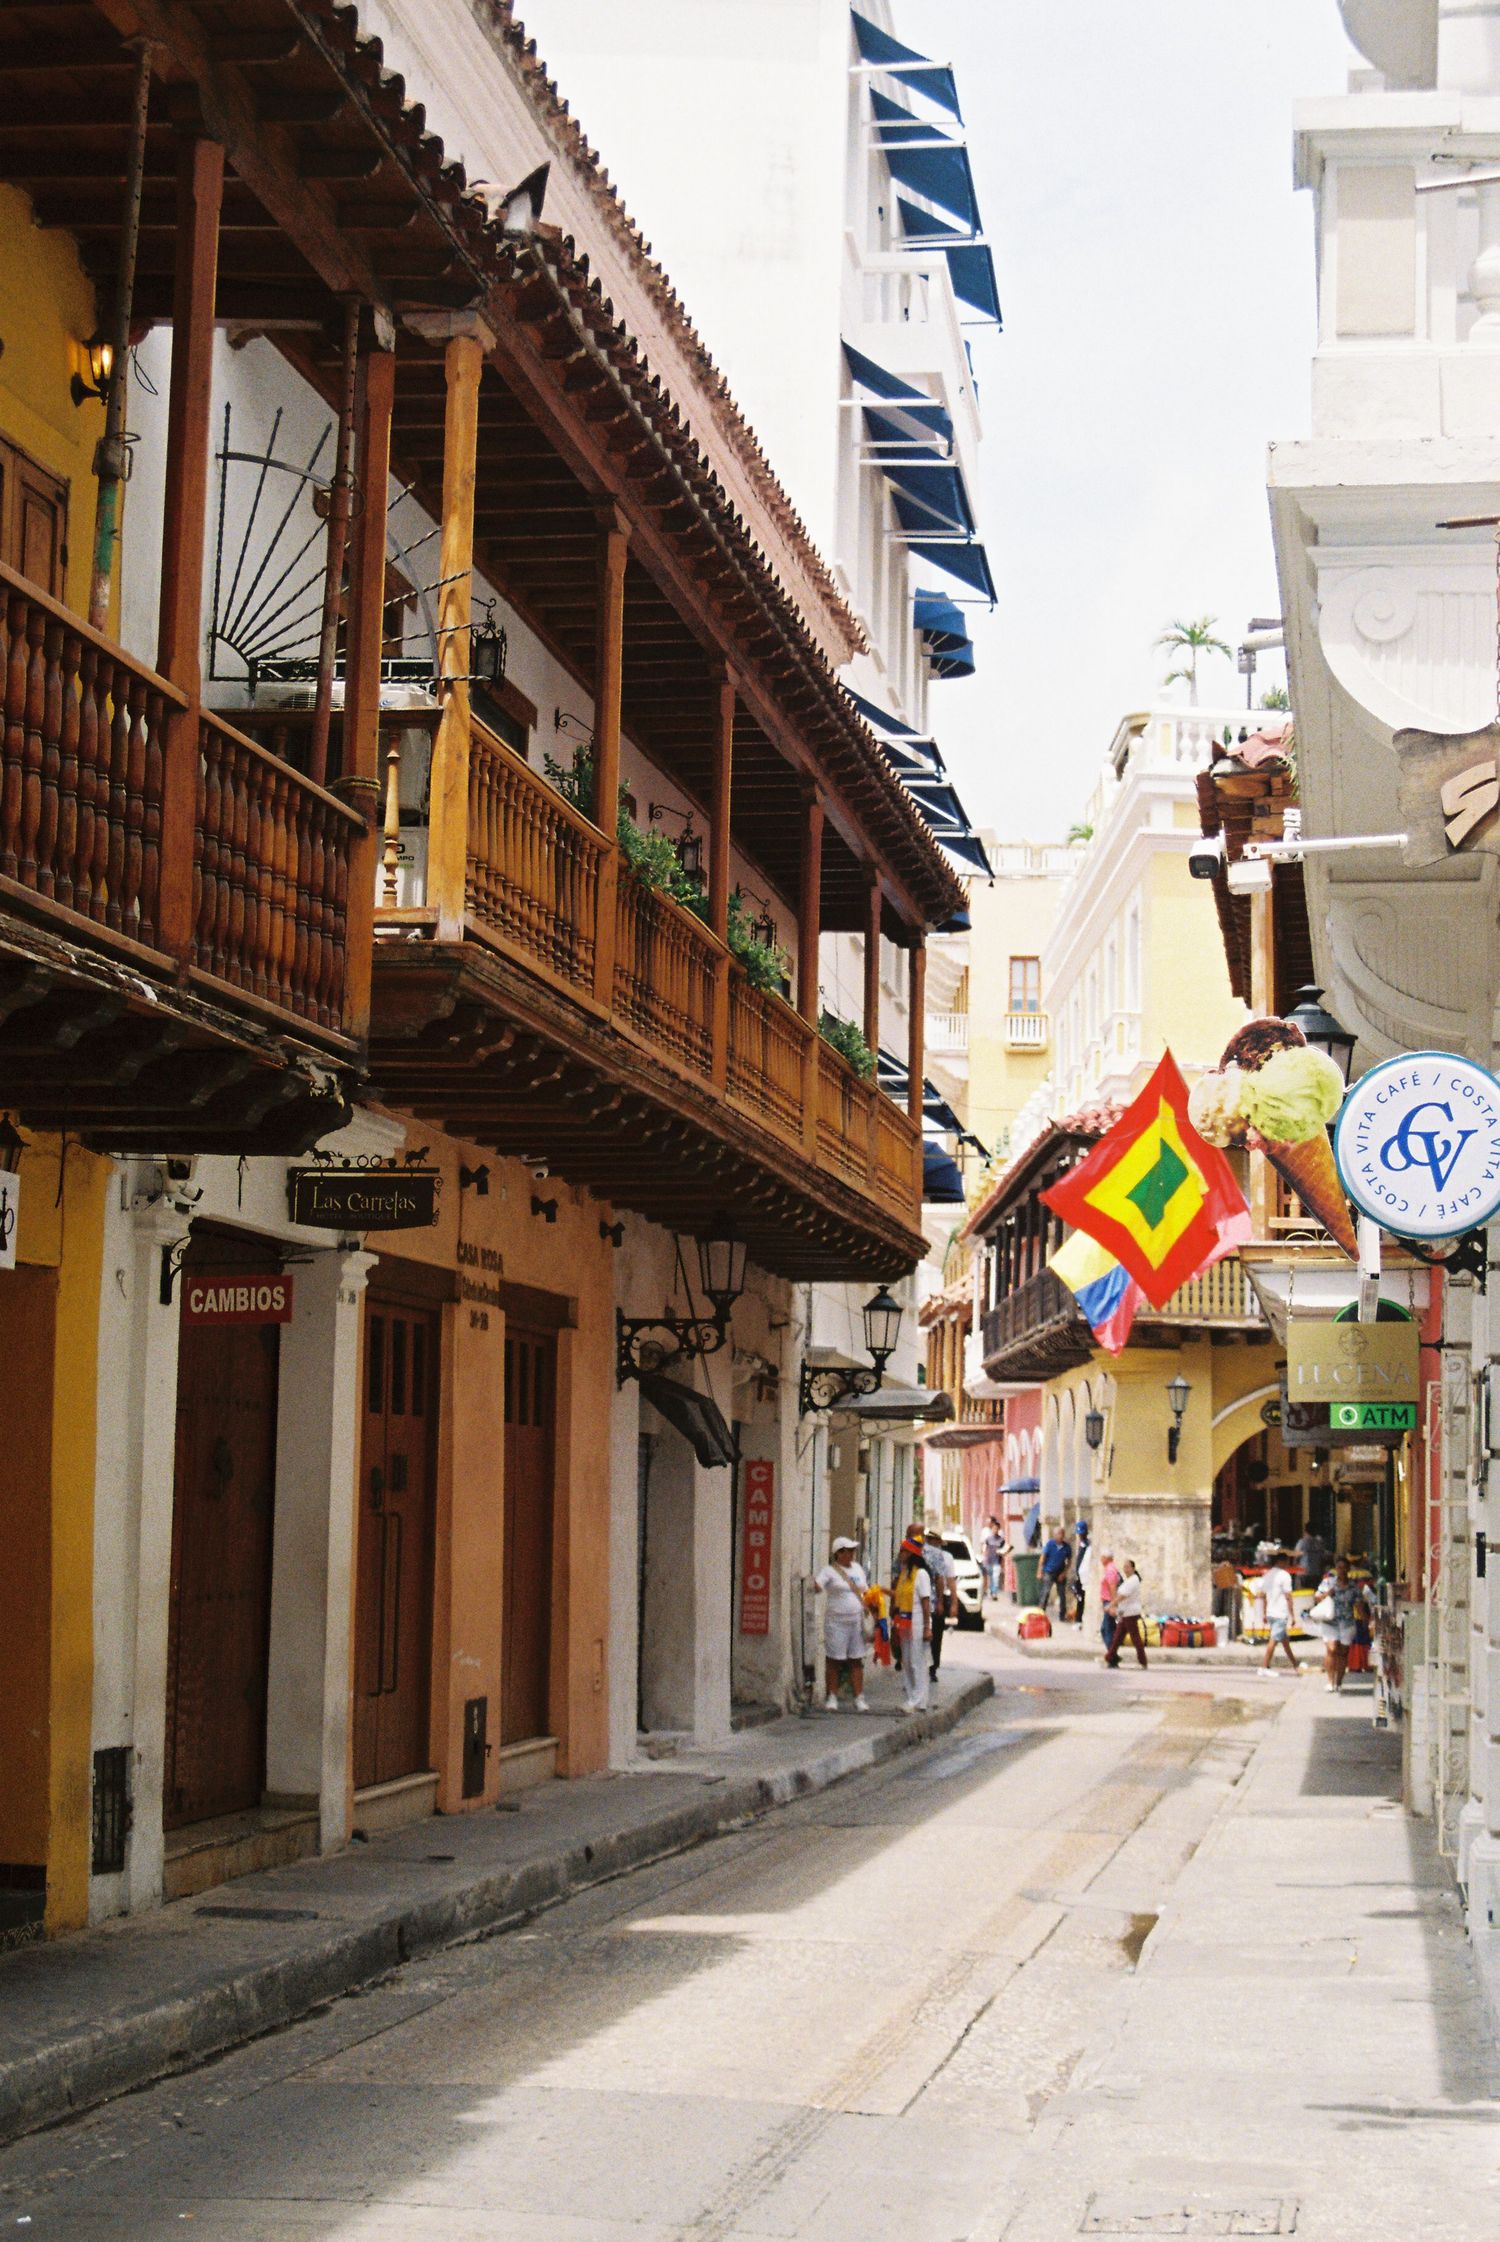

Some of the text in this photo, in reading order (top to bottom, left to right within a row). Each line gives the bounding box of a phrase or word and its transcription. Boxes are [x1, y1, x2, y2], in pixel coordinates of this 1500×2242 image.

[1376, 1071, 1421, 1104] CAFÉ
[1451, 1078, 1498, 1128] COSTA
[1357, 1111, 1376, 1153] VITA
[1482, 1137, 1500, 1180] VITA
[312, 1186, 342, 1210] Las
[1361, 1163, 1409, 1212] COSTA
[1437, 1187, 1482, 1219] CAFÉ
[190, 1285, 285, 1313] CAMBIOS
[1297, 1362, 1412, 1385] LUCENA
[1362, 1407, 1409, 1425] ATM
[747, 1466, 769, 1590] CAMBIO
